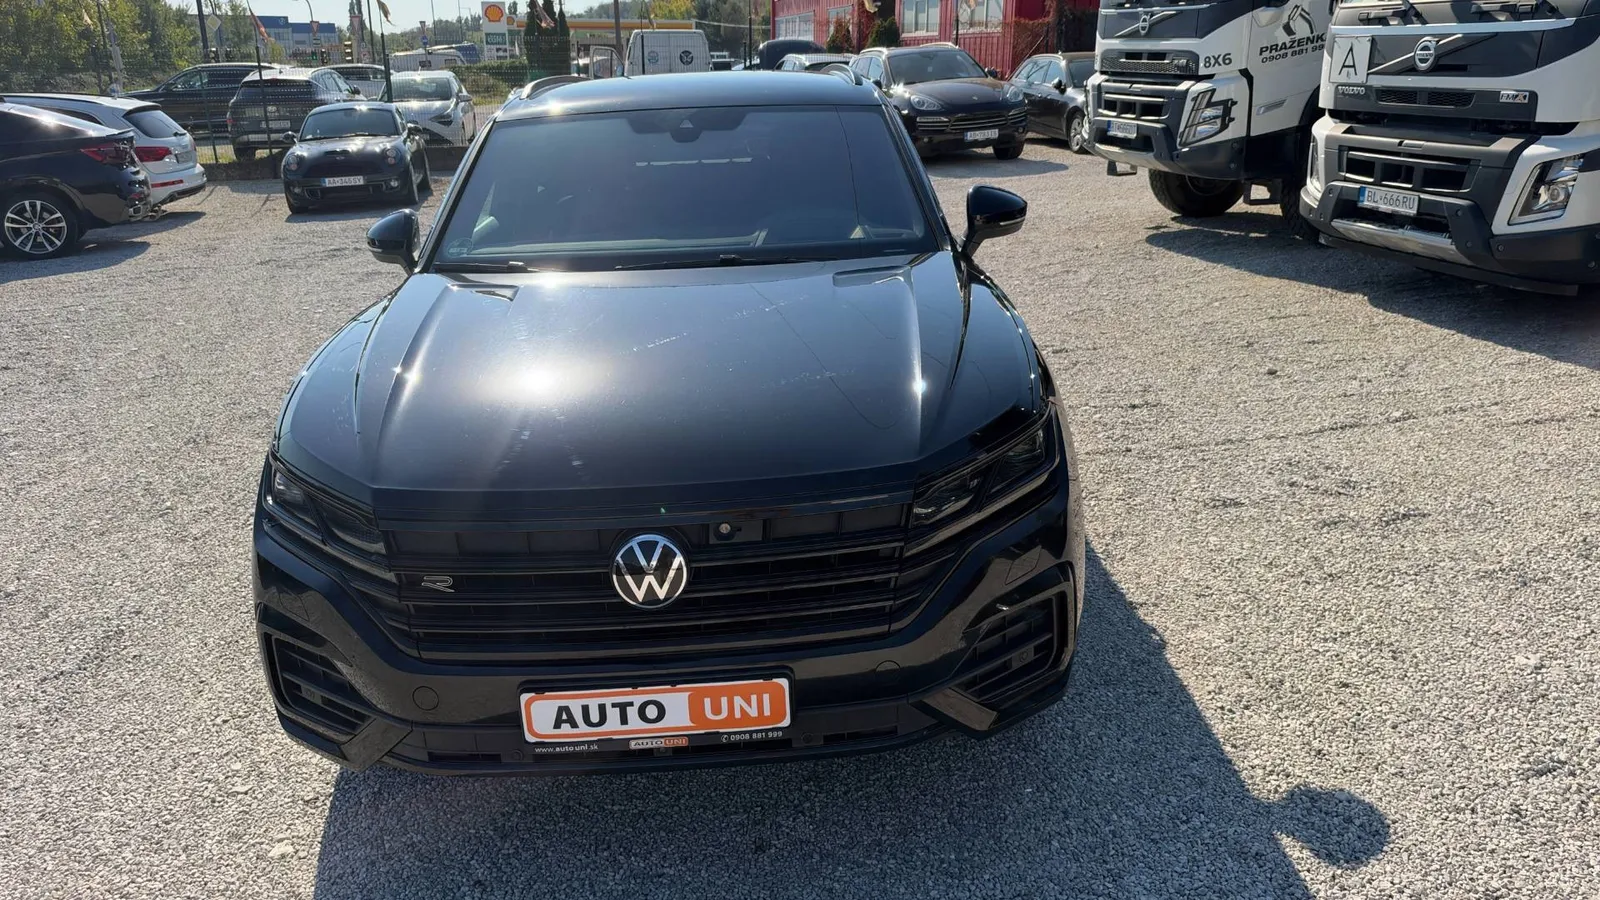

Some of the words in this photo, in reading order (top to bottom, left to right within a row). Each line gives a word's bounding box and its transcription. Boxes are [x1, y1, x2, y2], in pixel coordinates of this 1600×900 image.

[1258, 32, 1326, 56] PRAŽENK
[1203, 53, 1232, 69] 8X6
[1261, 53, 1288, 64] 0908
[1291, 48, 1309, 58] 881
[1311, 43, 1325, 52] 99
[1338, 41, 1358, 76] A
[1337, 86, 1366, 95] VOLVO
[552, 699, 666, 730] AUTO
[703, 693, 772, 721] UNI
[633, 739, 664, 748] AUTO
[665, 738, 687, 746] UNI
[730, 733, 750, 742] 0908
[752, 732, 766, 740] 881
[768, 731, 783, 739] 999
